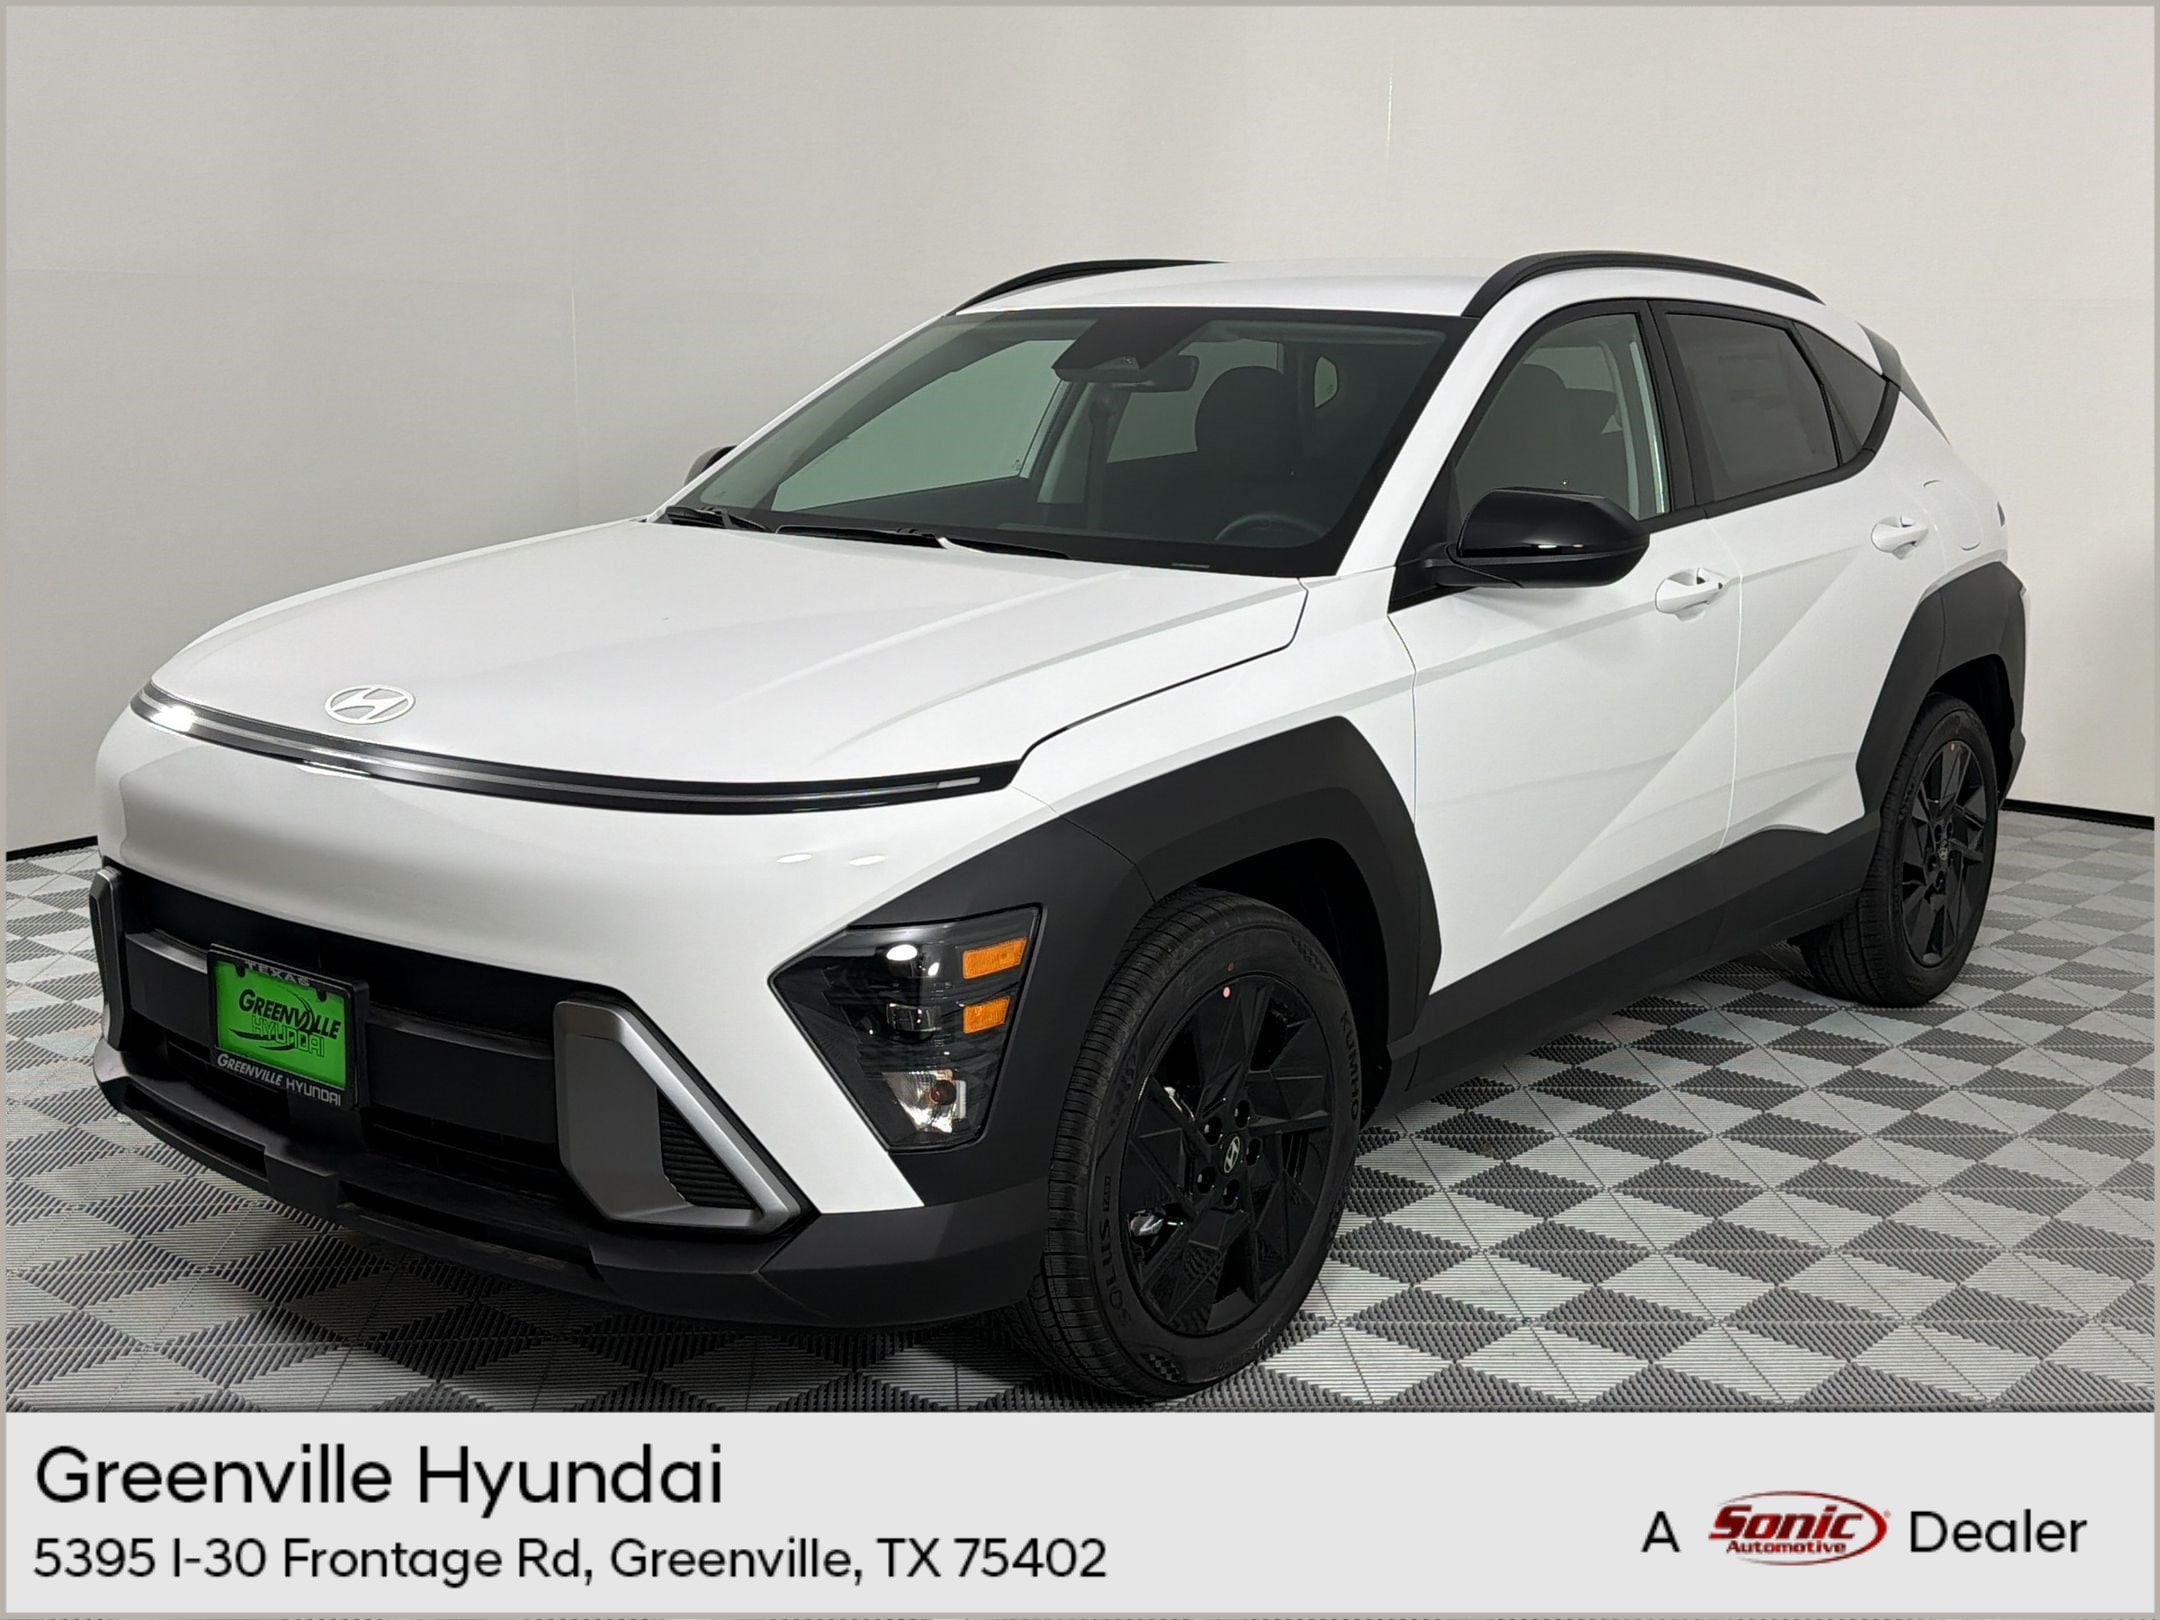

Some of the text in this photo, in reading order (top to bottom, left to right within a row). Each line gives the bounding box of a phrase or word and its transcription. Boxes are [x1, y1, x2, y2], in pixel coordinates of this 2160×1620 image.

[244, 960, 311, 986] TEXAS
[239, 989, 342, 1039] GREENVILLE
[251, 1015, 325, 1057] HYUNDAI
[217, 1053, 341, 1106] GREENVILLE HYUNDAI
[1340, 1009, 1359, 1121] KUMHO
[1101, 1218, 1131, 1327] SOLUS
